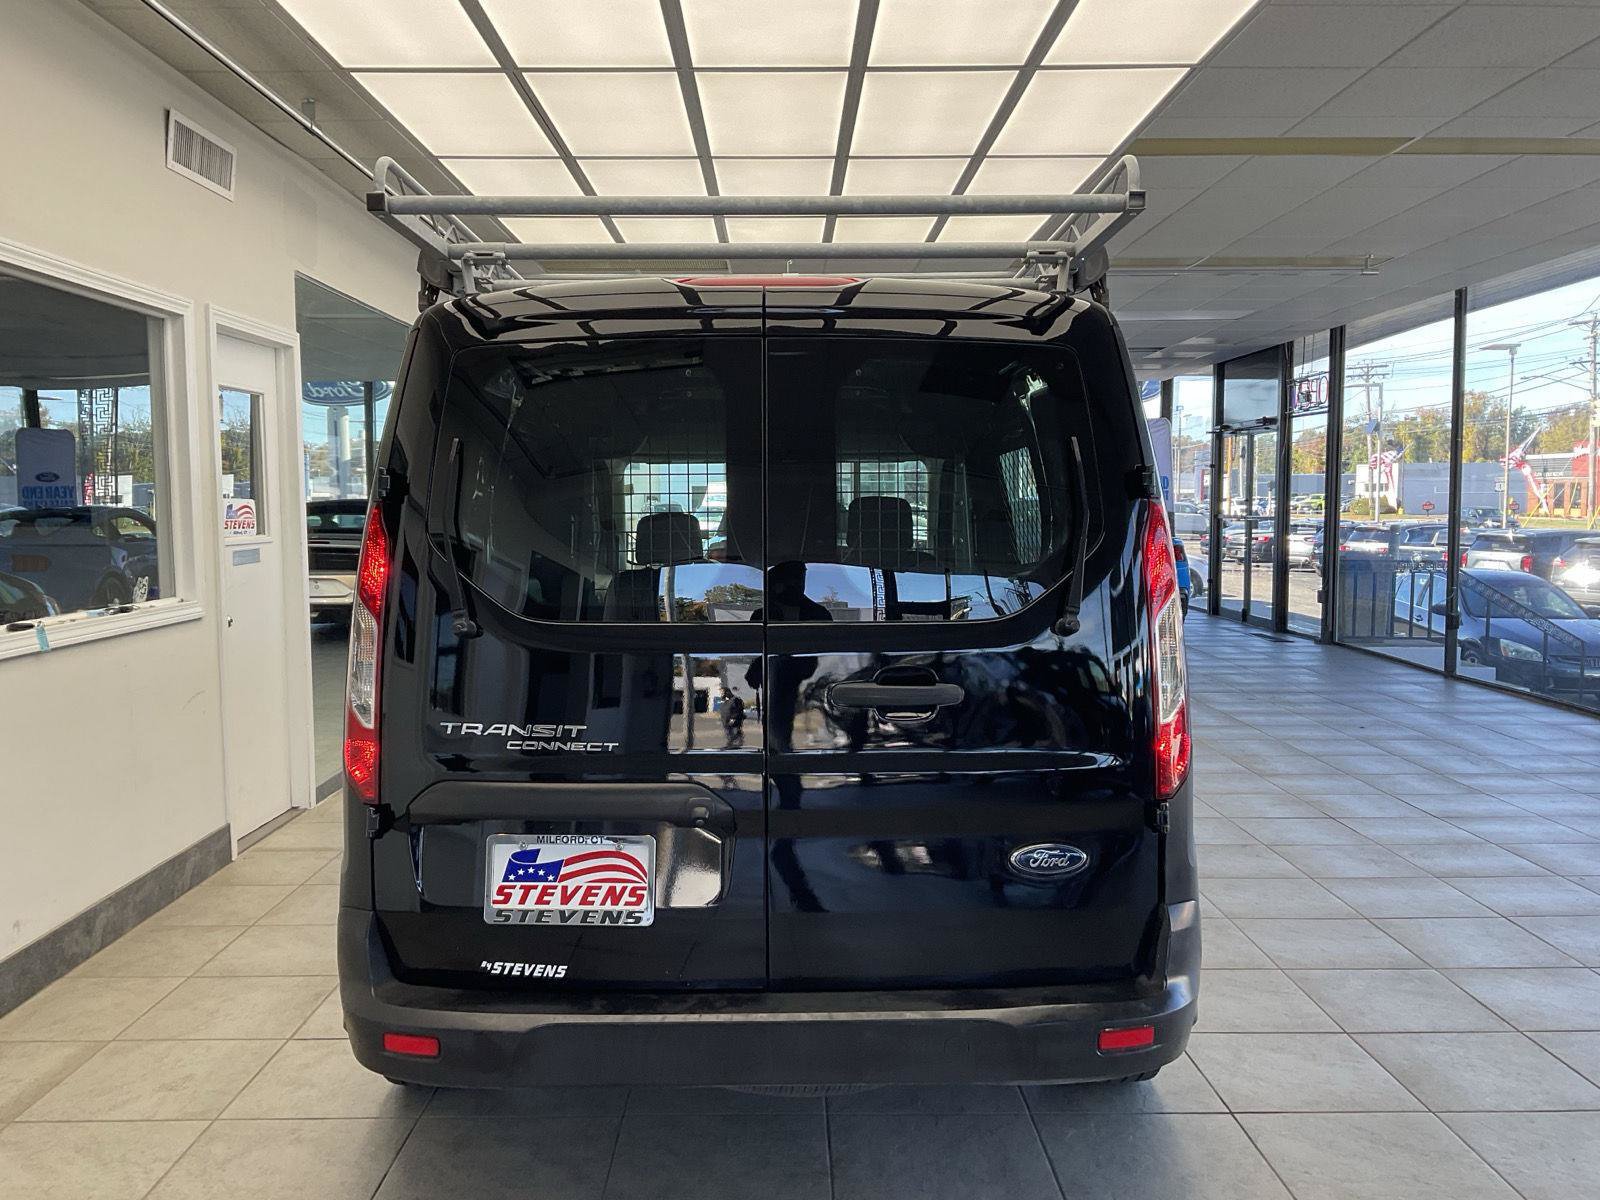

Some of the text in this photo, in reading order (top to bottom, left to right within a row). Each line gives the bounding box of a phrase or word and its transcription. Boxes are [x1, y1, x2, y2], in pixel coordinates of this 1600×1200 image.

[224, 520, 255, 530] STEVENS
[440, 722, 587, 738] TRANSIT
[506, 741, 619, 751] CONNECT
[590, 836, 605, 845] CT
[1029, 849, 1070, 868] Ford
[492, 885, 648, 906] STEVENS
[493, 909, 645, 925] STEVENS
[491, 961, 568, 978] STEVENS
